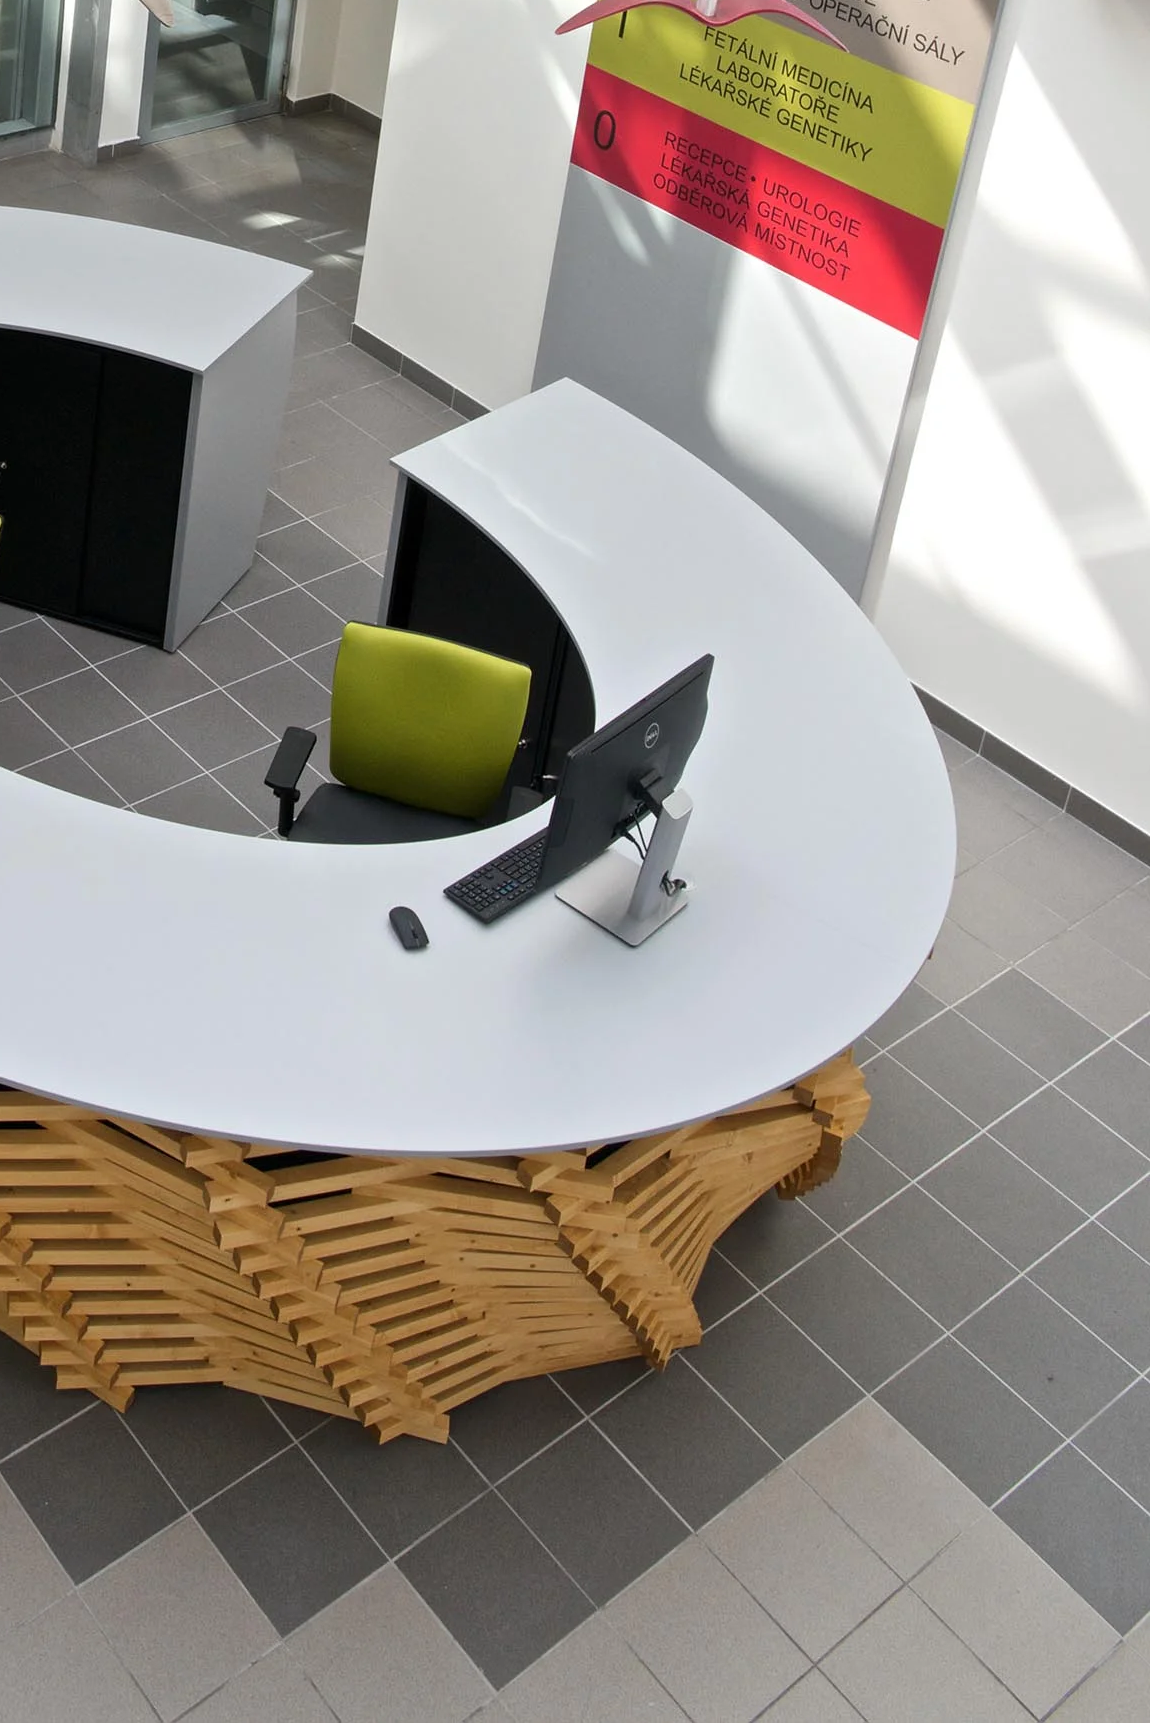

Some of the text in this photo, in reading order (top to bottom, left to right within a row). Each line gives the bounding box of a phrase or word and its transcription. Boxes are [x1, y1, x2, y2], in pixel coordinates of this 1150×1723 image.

[703, 25, 874, 114] FETÁLNÍ MEDICÍNA
[716, 55, 840, 123] LABORATOŘE
[913, 33, 965, 65] SÁLY
[593, 110, 617, 150] 0
[679, 62, 874, 162] LÉKAŘSKÉ GENETIKY
[653, 173, 851, 281] ODBĚROVÁ MÍSTNOST
[660, 153, 849, 257] LÉKAŘSKÁ GENETIKA
[664, 131, 863, 237] RECEPCE UROLOGIE
